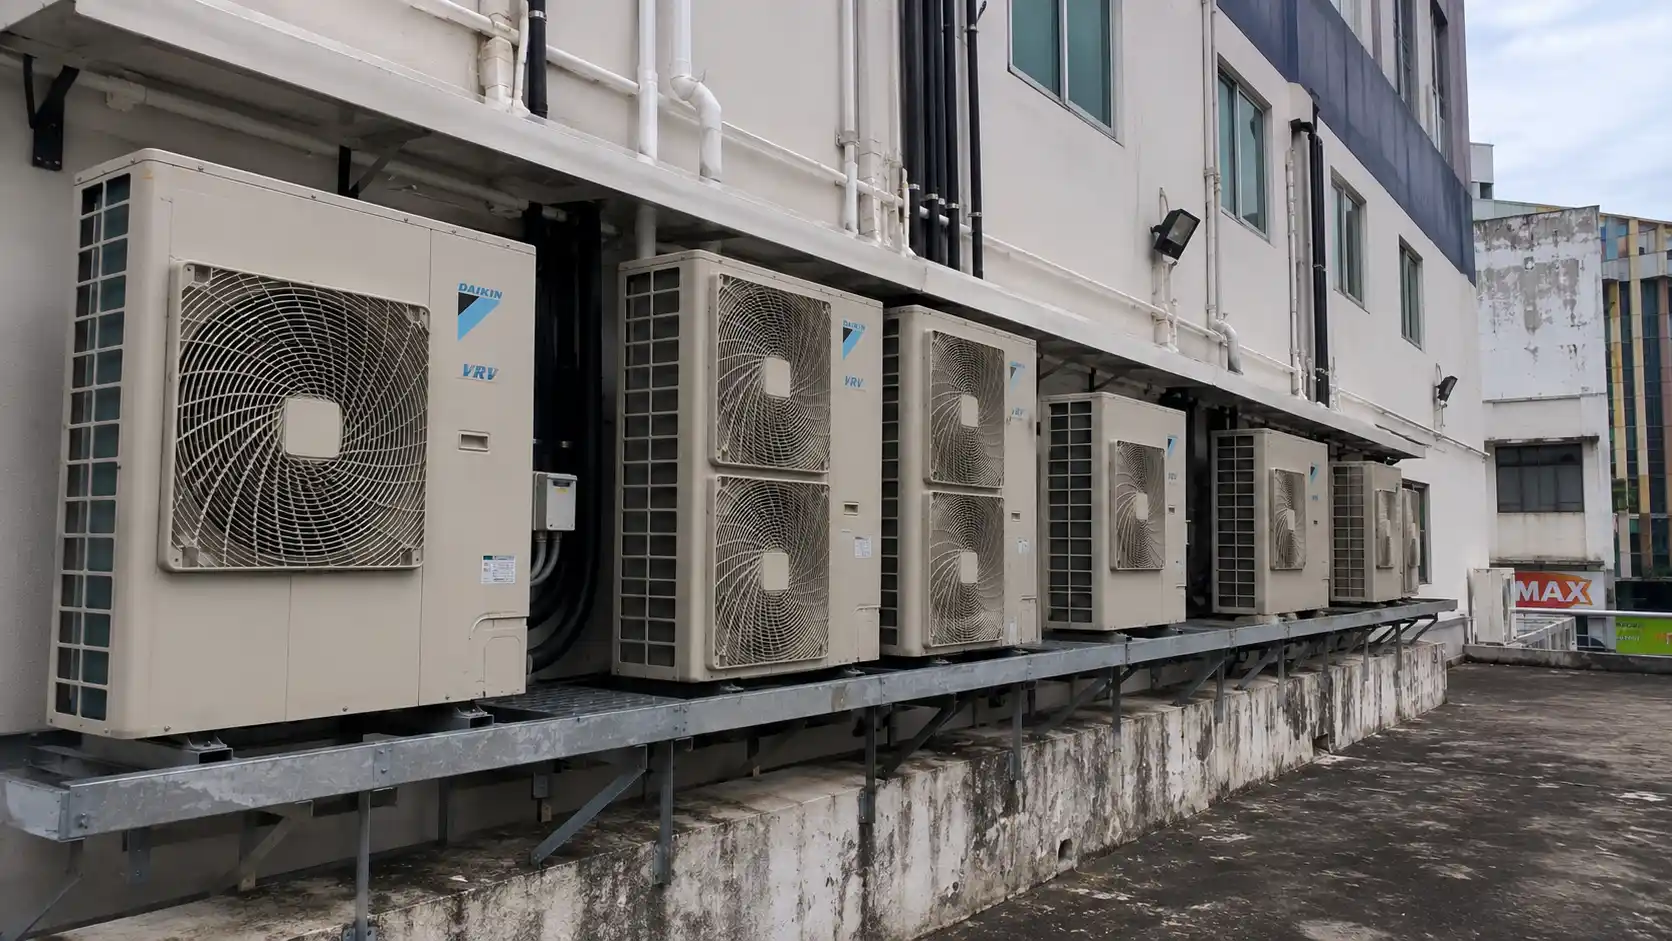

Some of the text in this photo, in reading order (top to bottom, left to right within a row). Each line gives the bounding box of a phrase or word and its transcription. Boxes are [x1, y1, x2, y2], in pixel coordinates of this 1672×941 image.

[458, 283, 503, 299] DAIKIN
[463, 363, 499, 380] VRV
[845, 375, 864, 388] VRV
[1515, 581, 1589, 602] MAX
